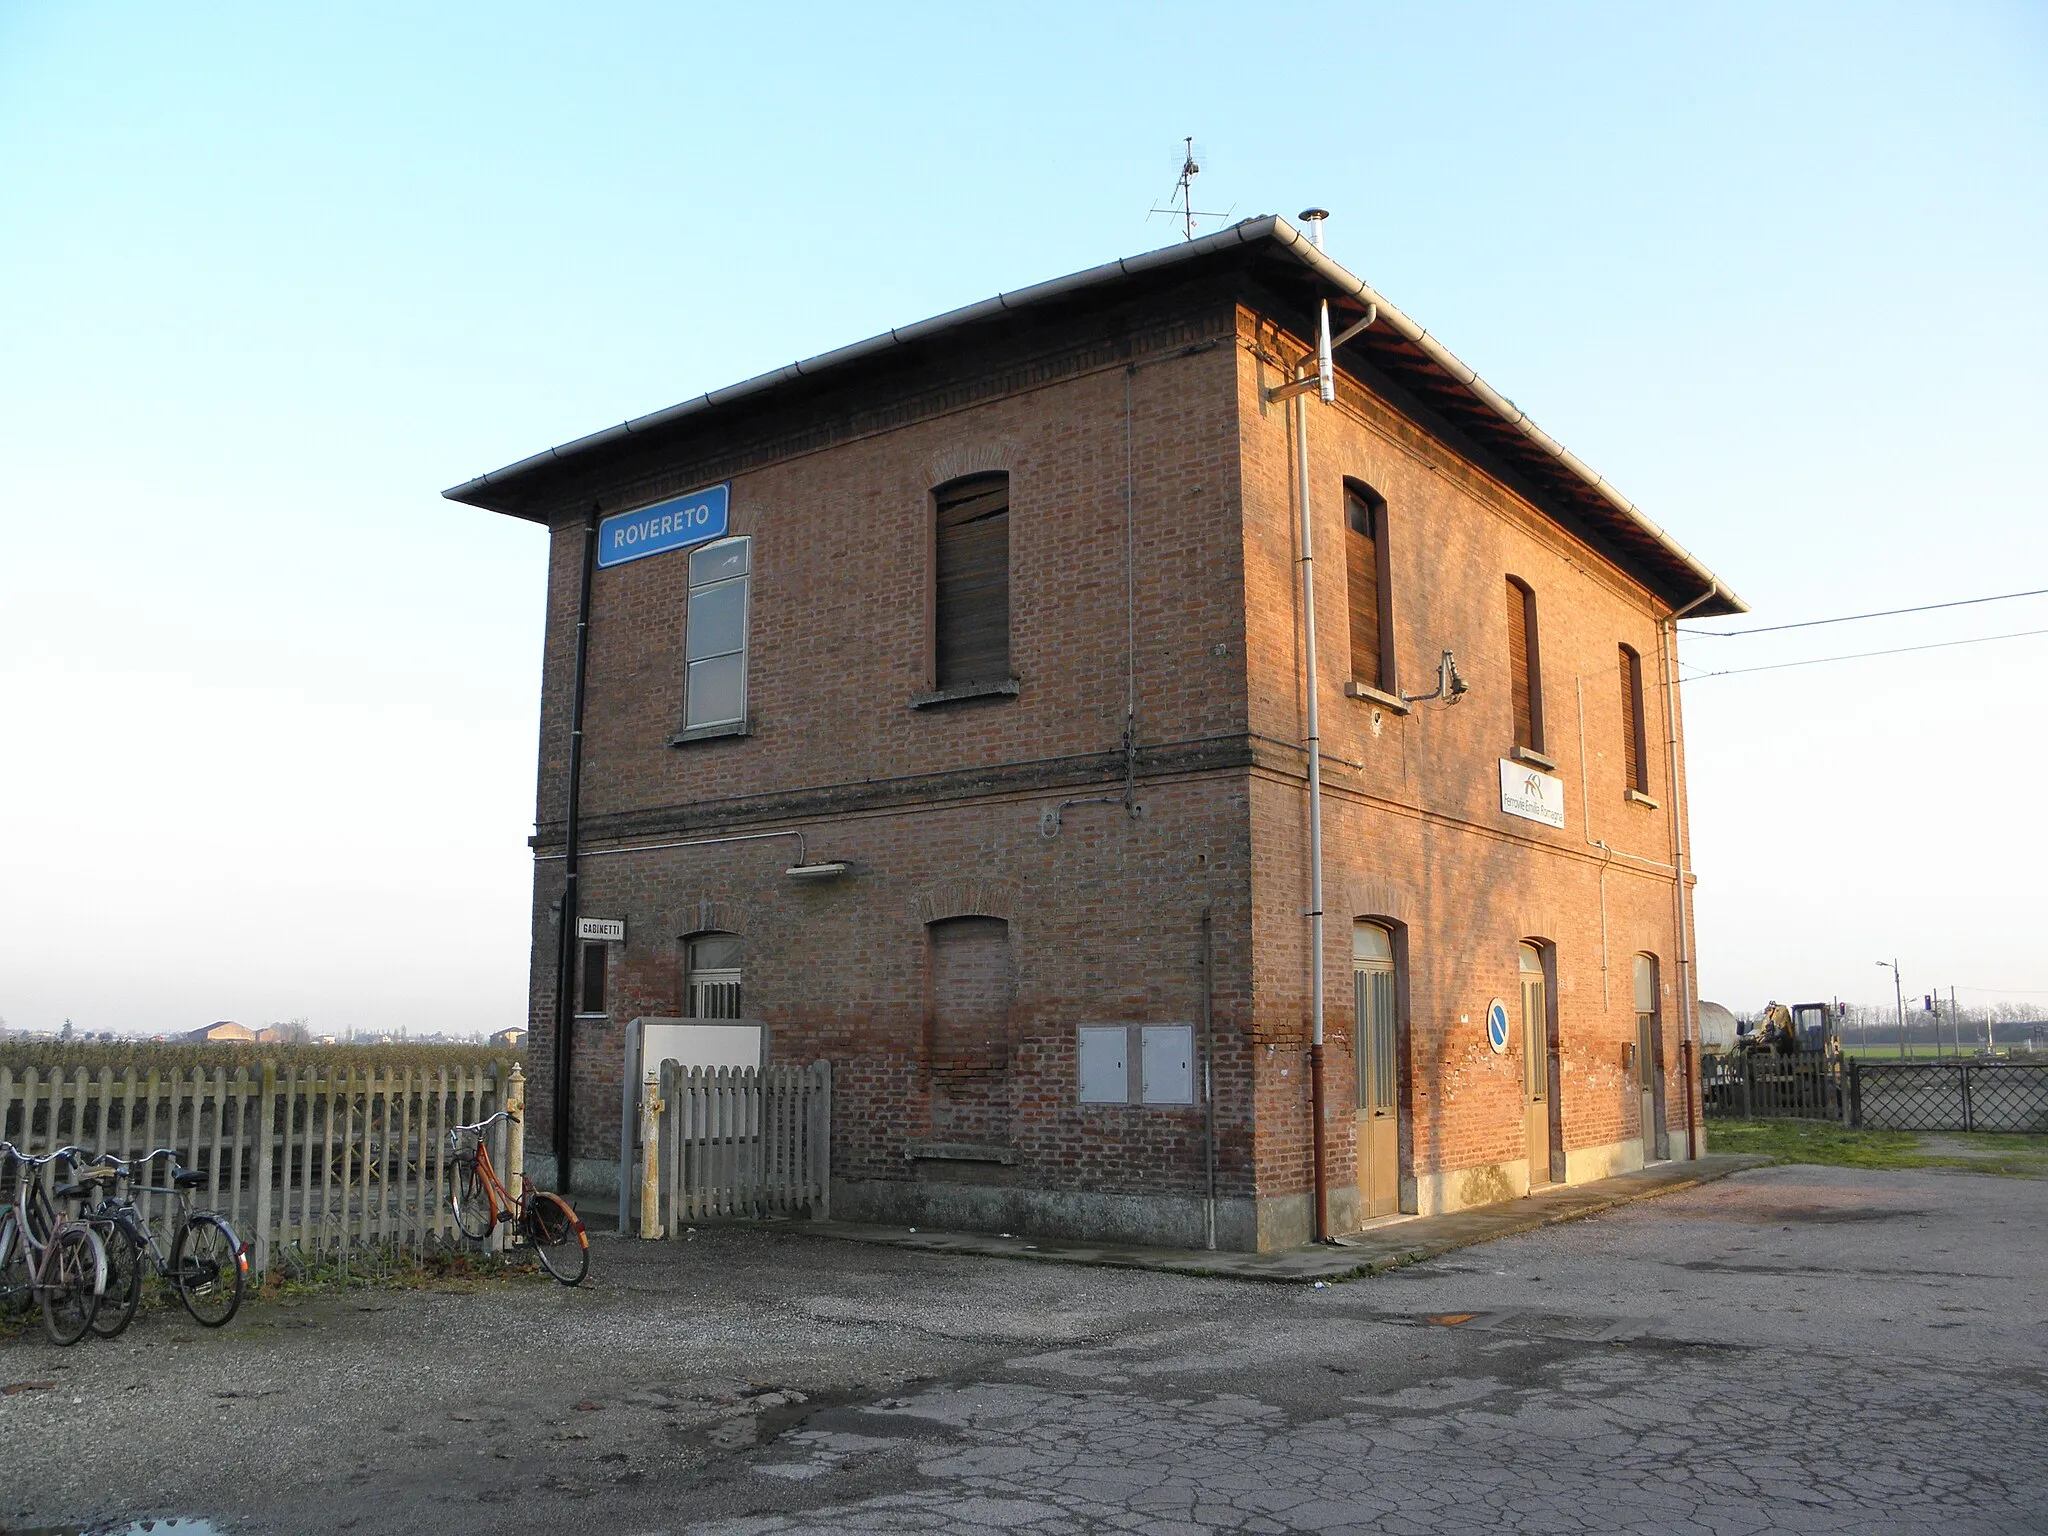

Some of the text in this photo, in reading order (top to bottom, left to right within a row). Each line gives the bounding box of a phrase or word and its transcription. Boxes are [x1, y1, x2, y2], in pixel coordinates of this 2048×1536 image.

[614, 504, 709, 549] ROVERETO
[1504, 793, 1525, 811] Ferrovie
[583, 923, 620, 935] GABINETTI
